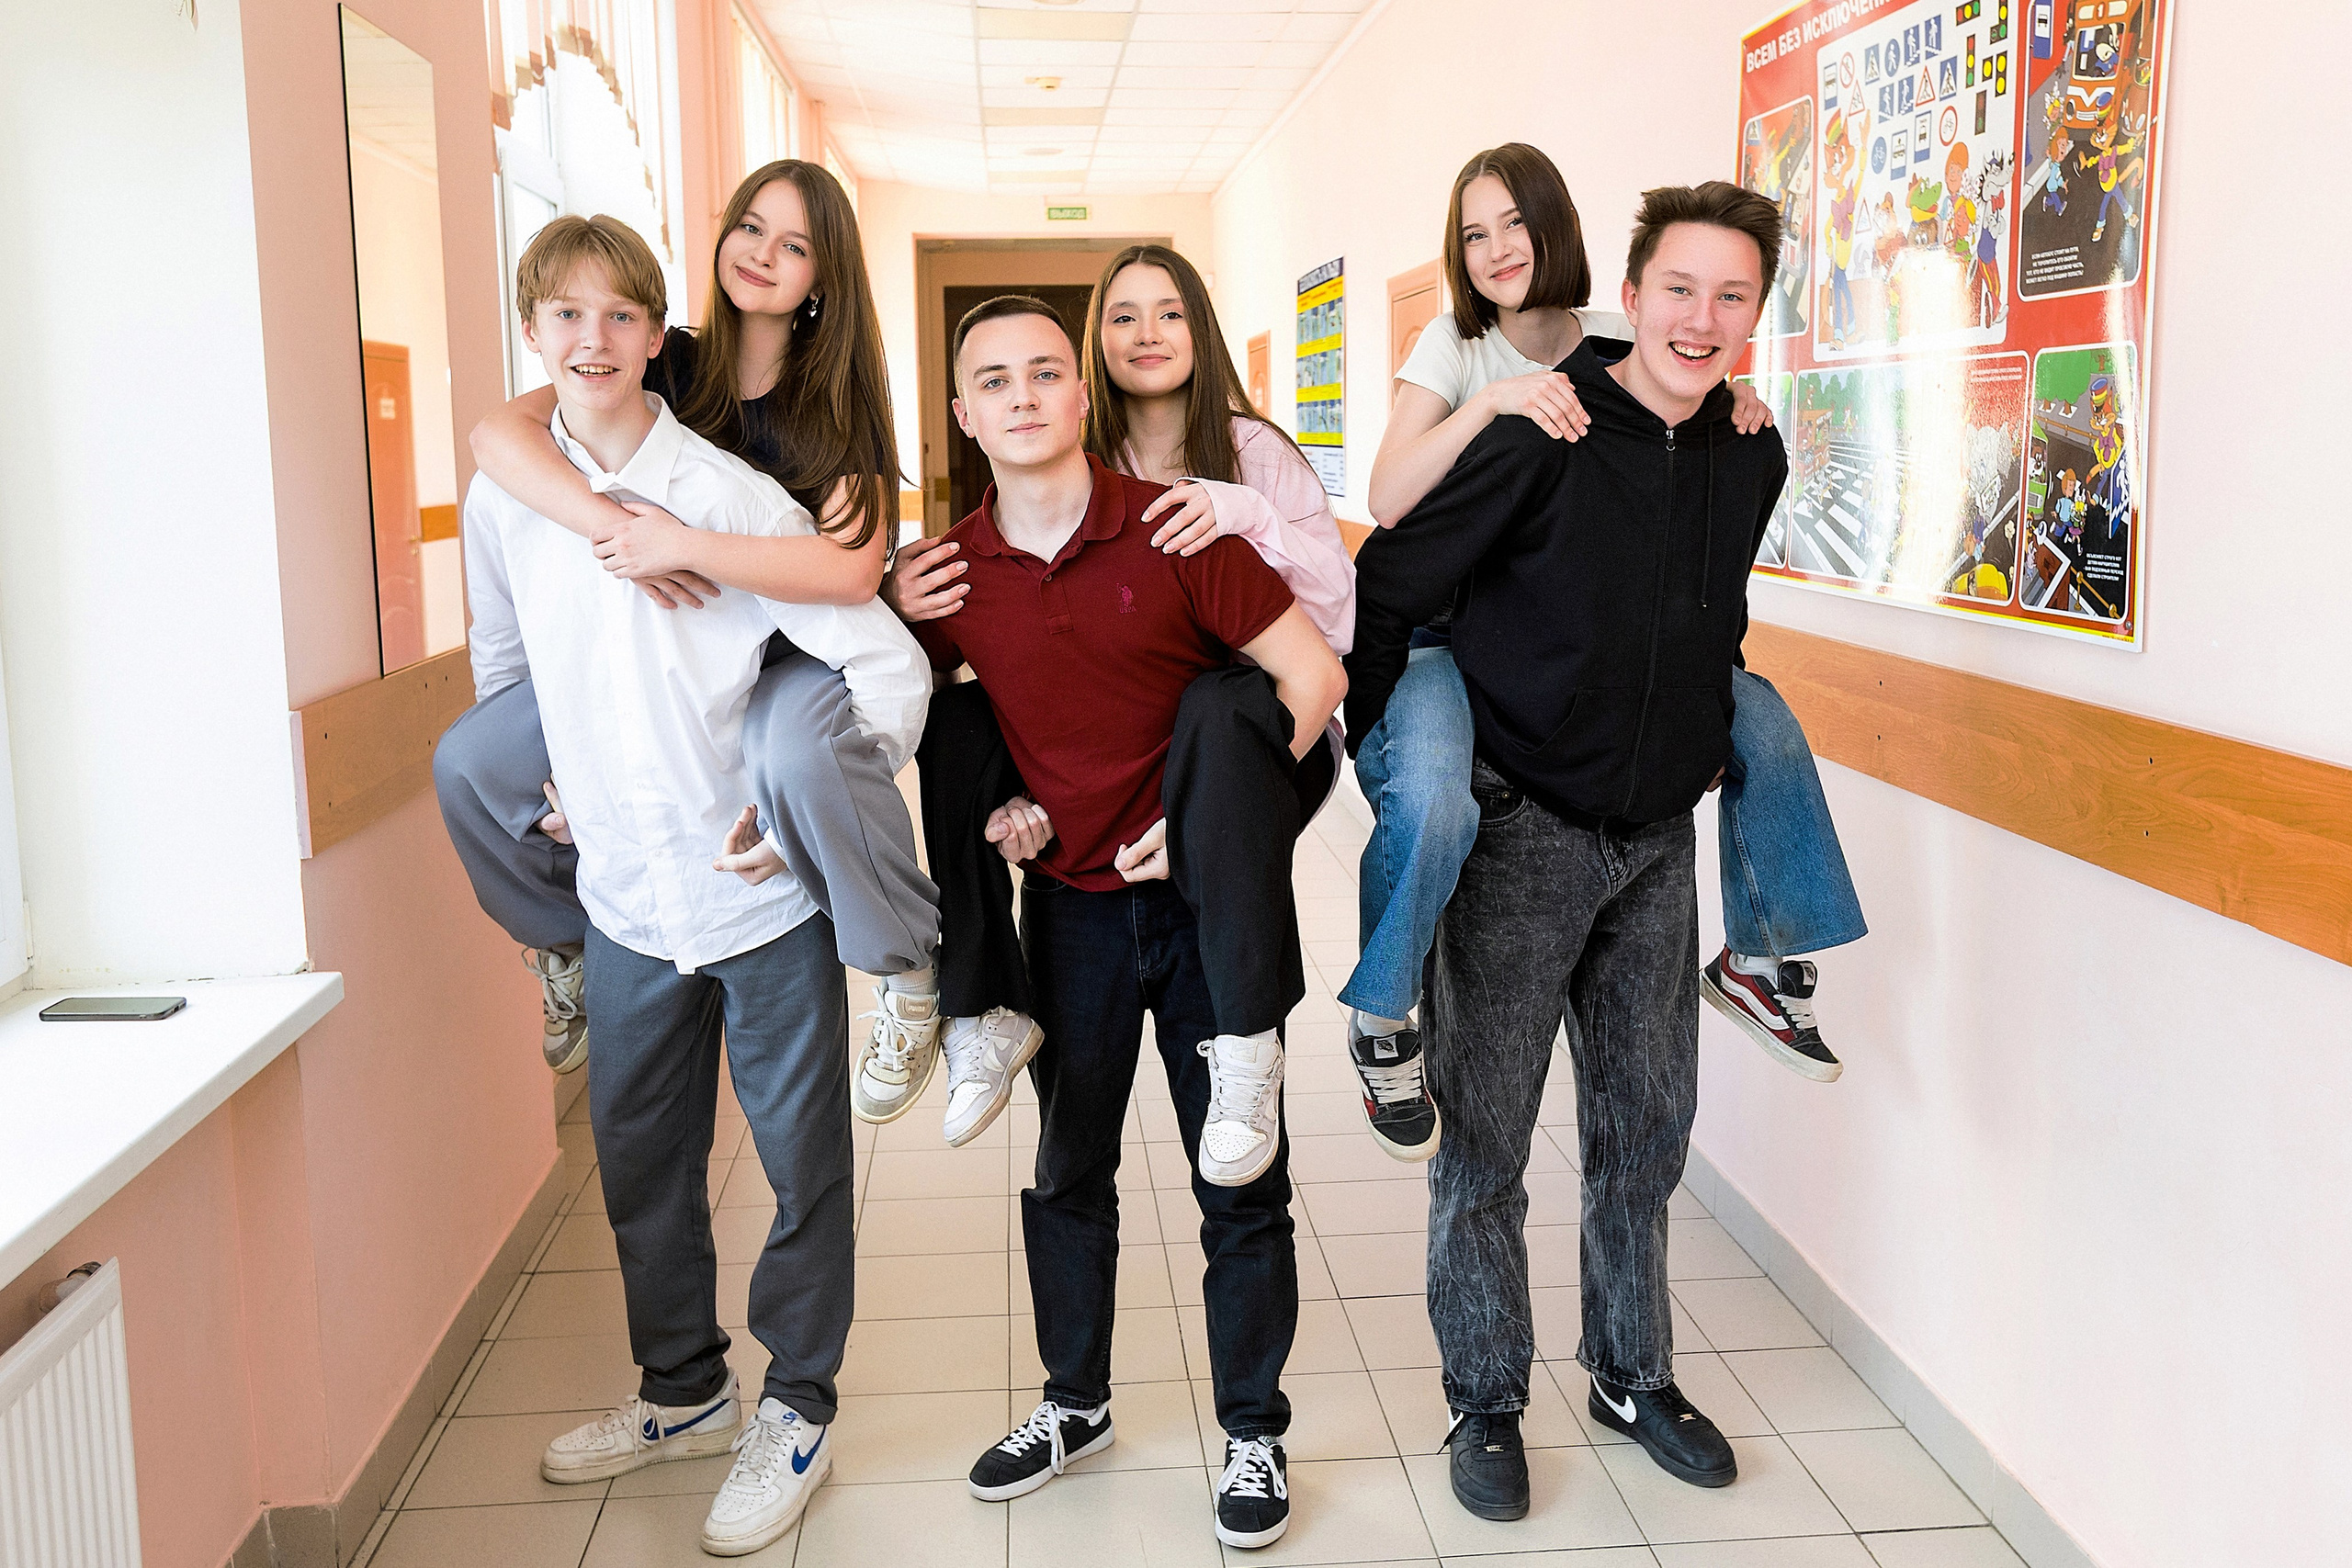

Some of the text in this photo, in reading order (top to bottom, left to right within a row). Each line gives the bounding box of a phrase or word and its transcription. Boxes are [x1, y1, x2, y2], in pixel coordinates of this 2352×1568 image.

[1746, 0, 1890, 73] ВСЕМ БЕЗ ИСКЛЮЧЕ
